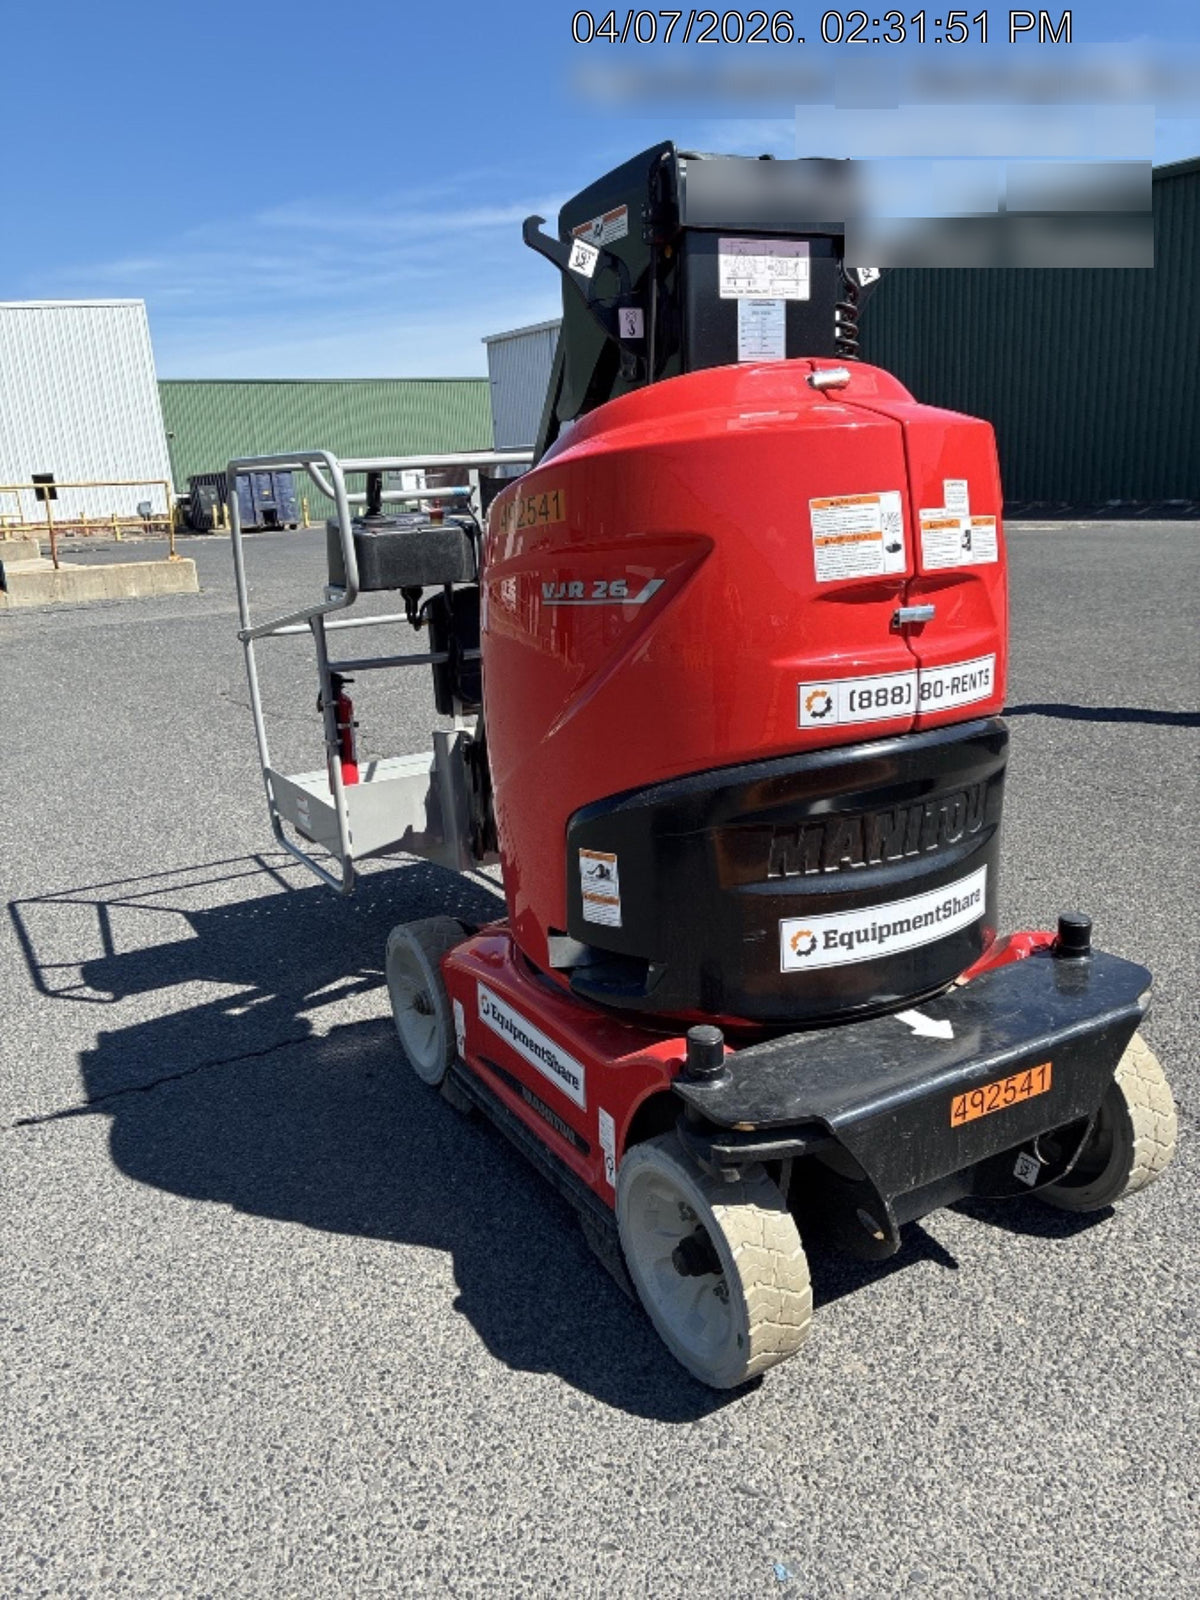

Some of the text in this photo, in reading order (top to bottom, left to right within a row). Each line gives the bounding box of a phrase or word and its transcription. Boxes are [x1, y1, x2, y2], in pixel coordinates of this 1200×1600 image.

[542, 579, 628, 598] VJR 26
[849, 667, 990, 712] (888) 80-RENTS
[768, 782, 988, 878] MANITOU
[823, 888, 981, 950] EquipmentShare
[491, 1003, 580, 1090] EquipmentShare
[954, 1066, 1047, 1120] 492541
